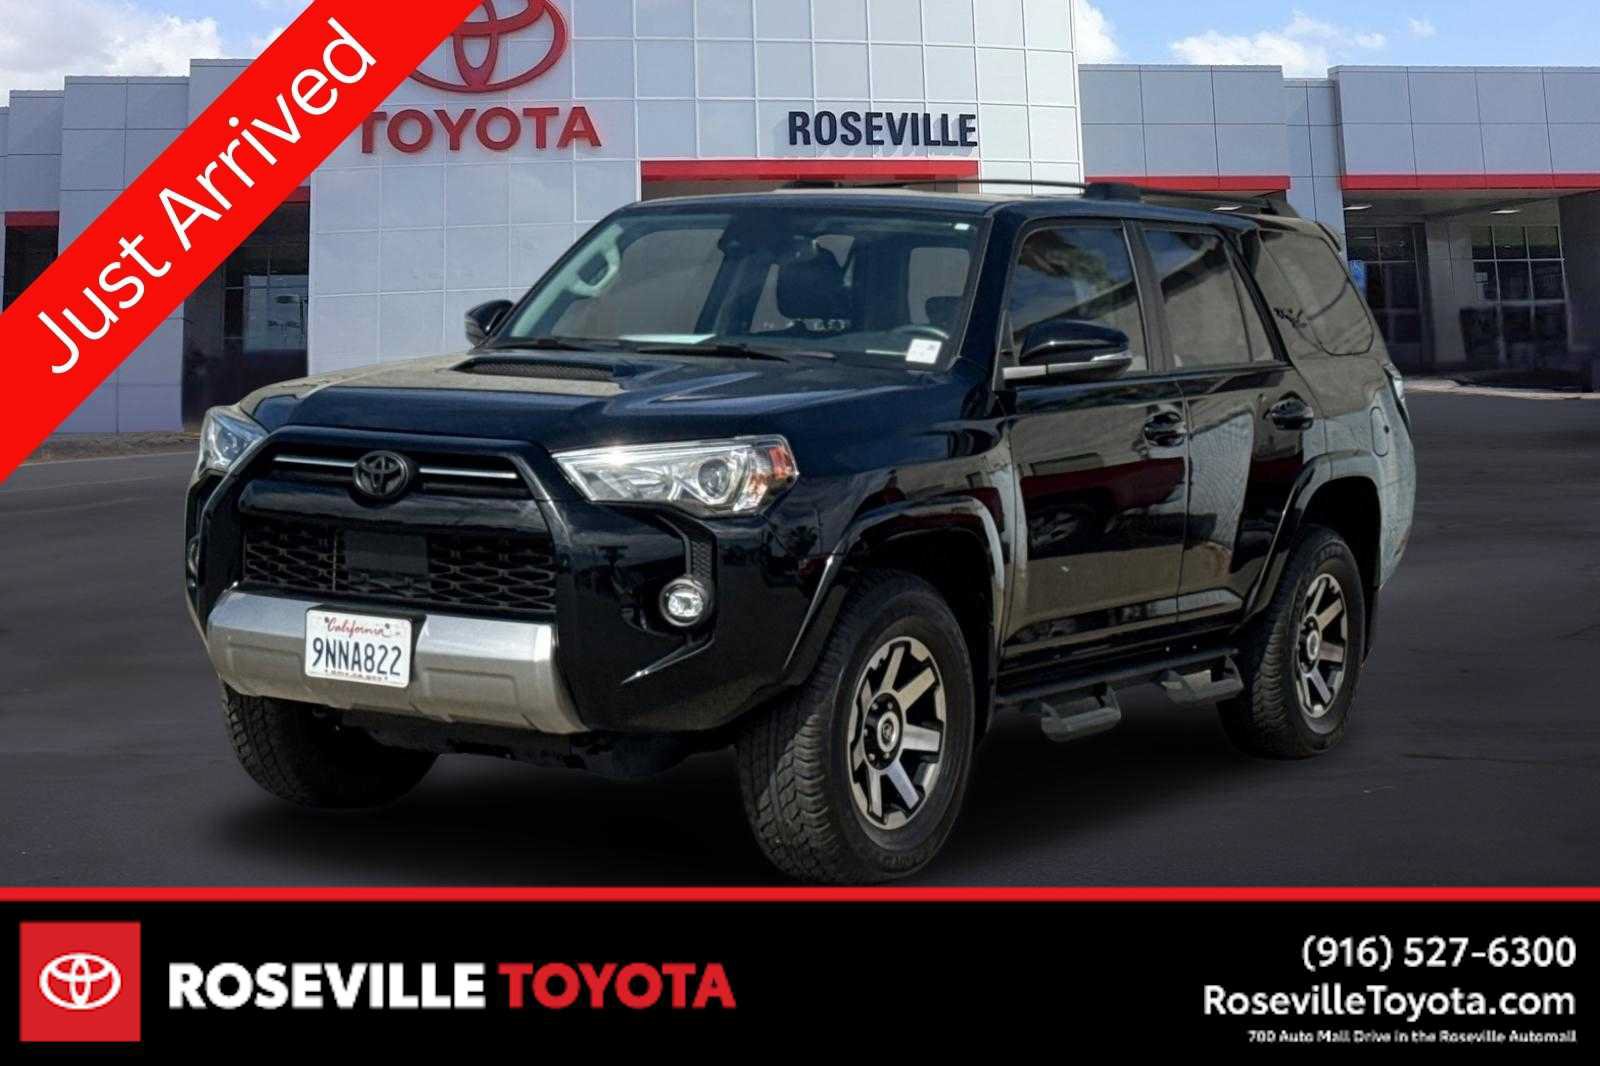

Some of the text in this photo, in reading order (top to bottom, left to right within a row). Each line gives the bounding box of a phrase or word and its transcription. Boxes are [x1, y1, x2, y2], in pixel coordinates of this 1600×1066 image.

[361, 106, 602, 154] TOYOTA
[787, 110, 978, 148] ROSEVILLE
[327, 616, 385, 639] California
[312, 637, 402, 676] 9NNA822
